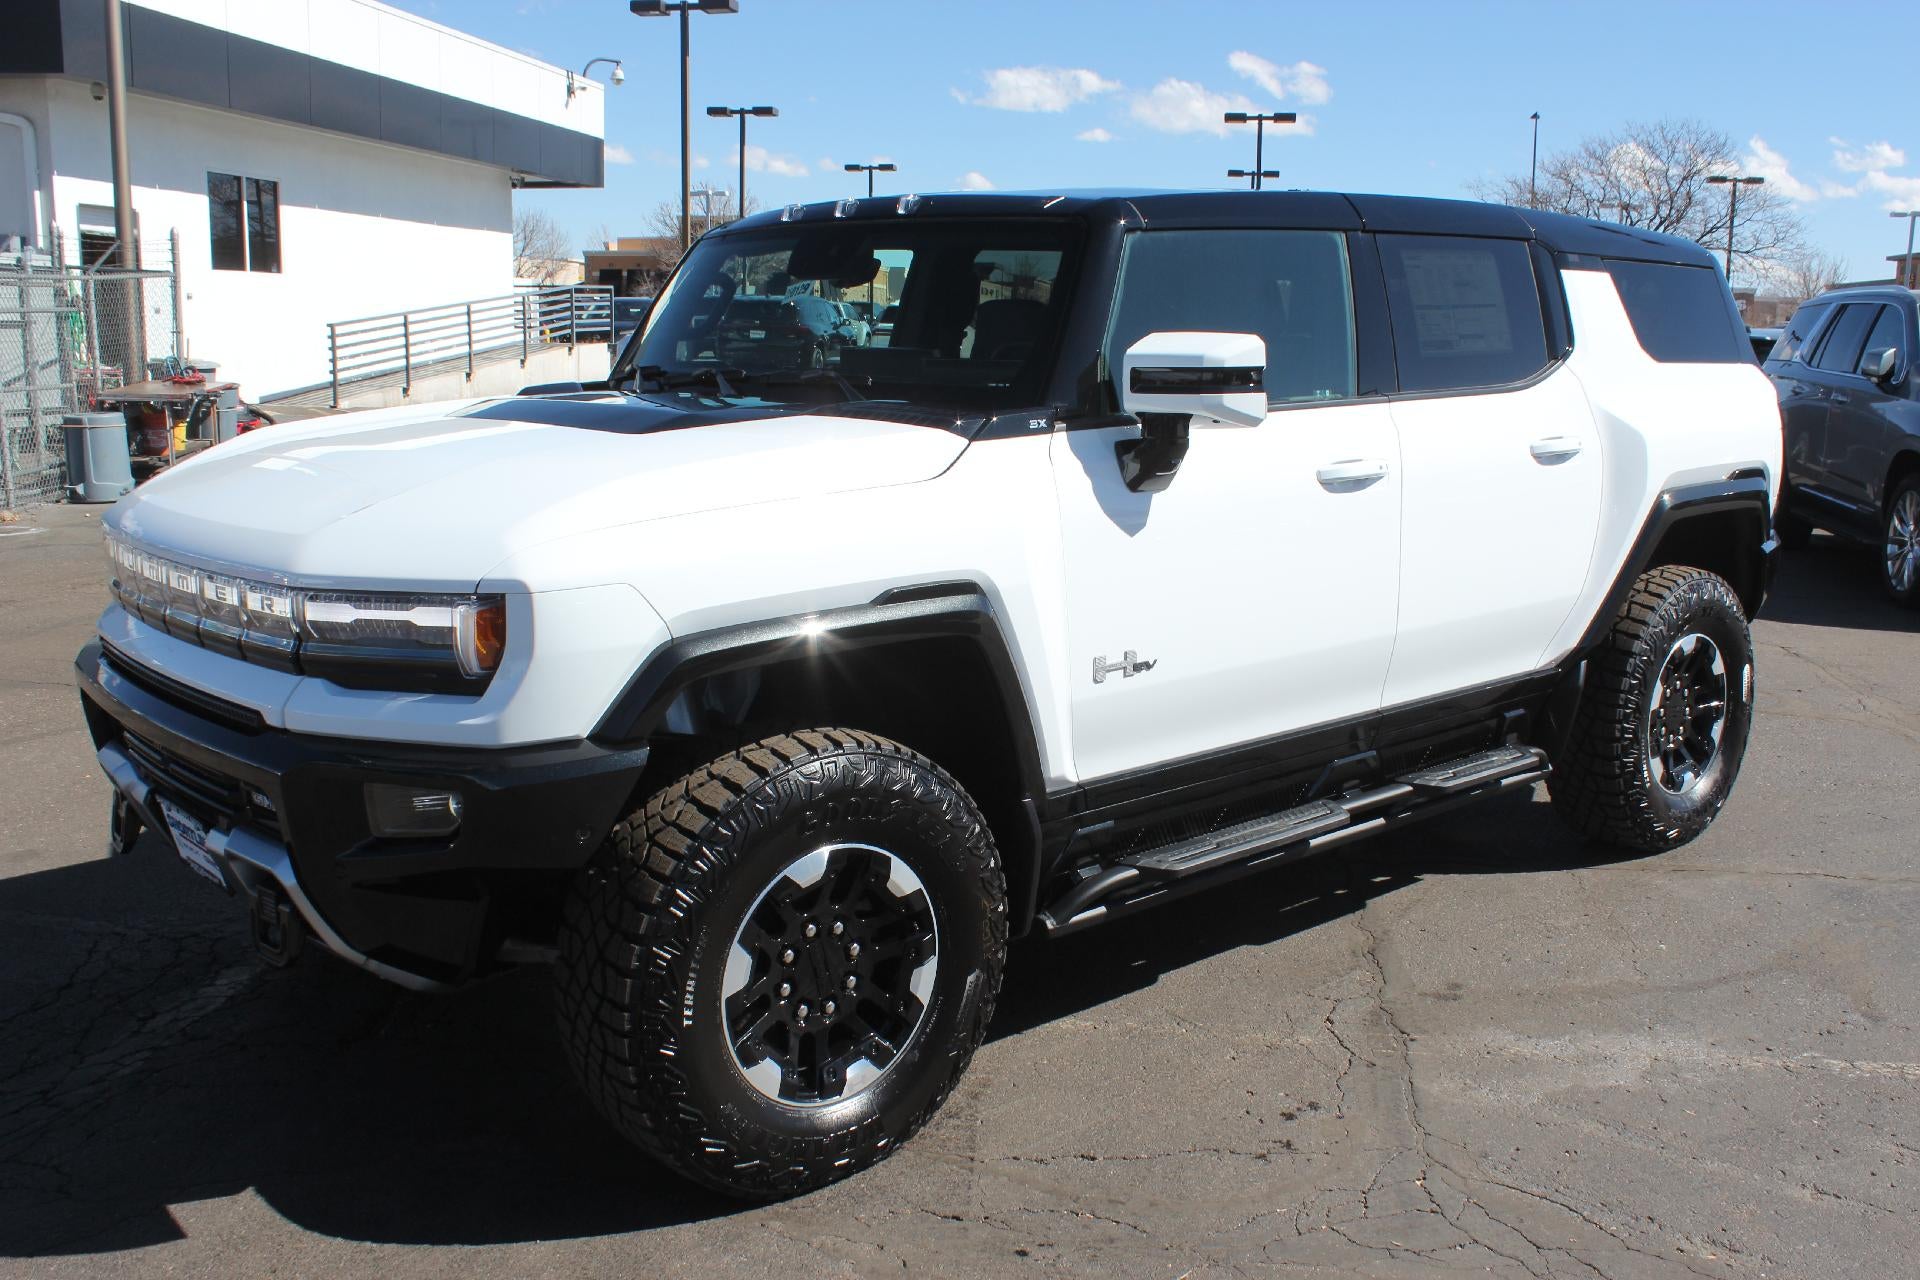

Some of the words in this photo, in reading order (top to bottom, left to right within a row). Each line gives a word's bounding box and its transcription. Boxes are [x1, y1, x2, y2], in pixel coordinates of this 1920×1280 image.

[1029, 418, 1048, 429] 3X
[107, 542, 290, 618] UMMER
[683, 924, 708, 1028] TERRITO
